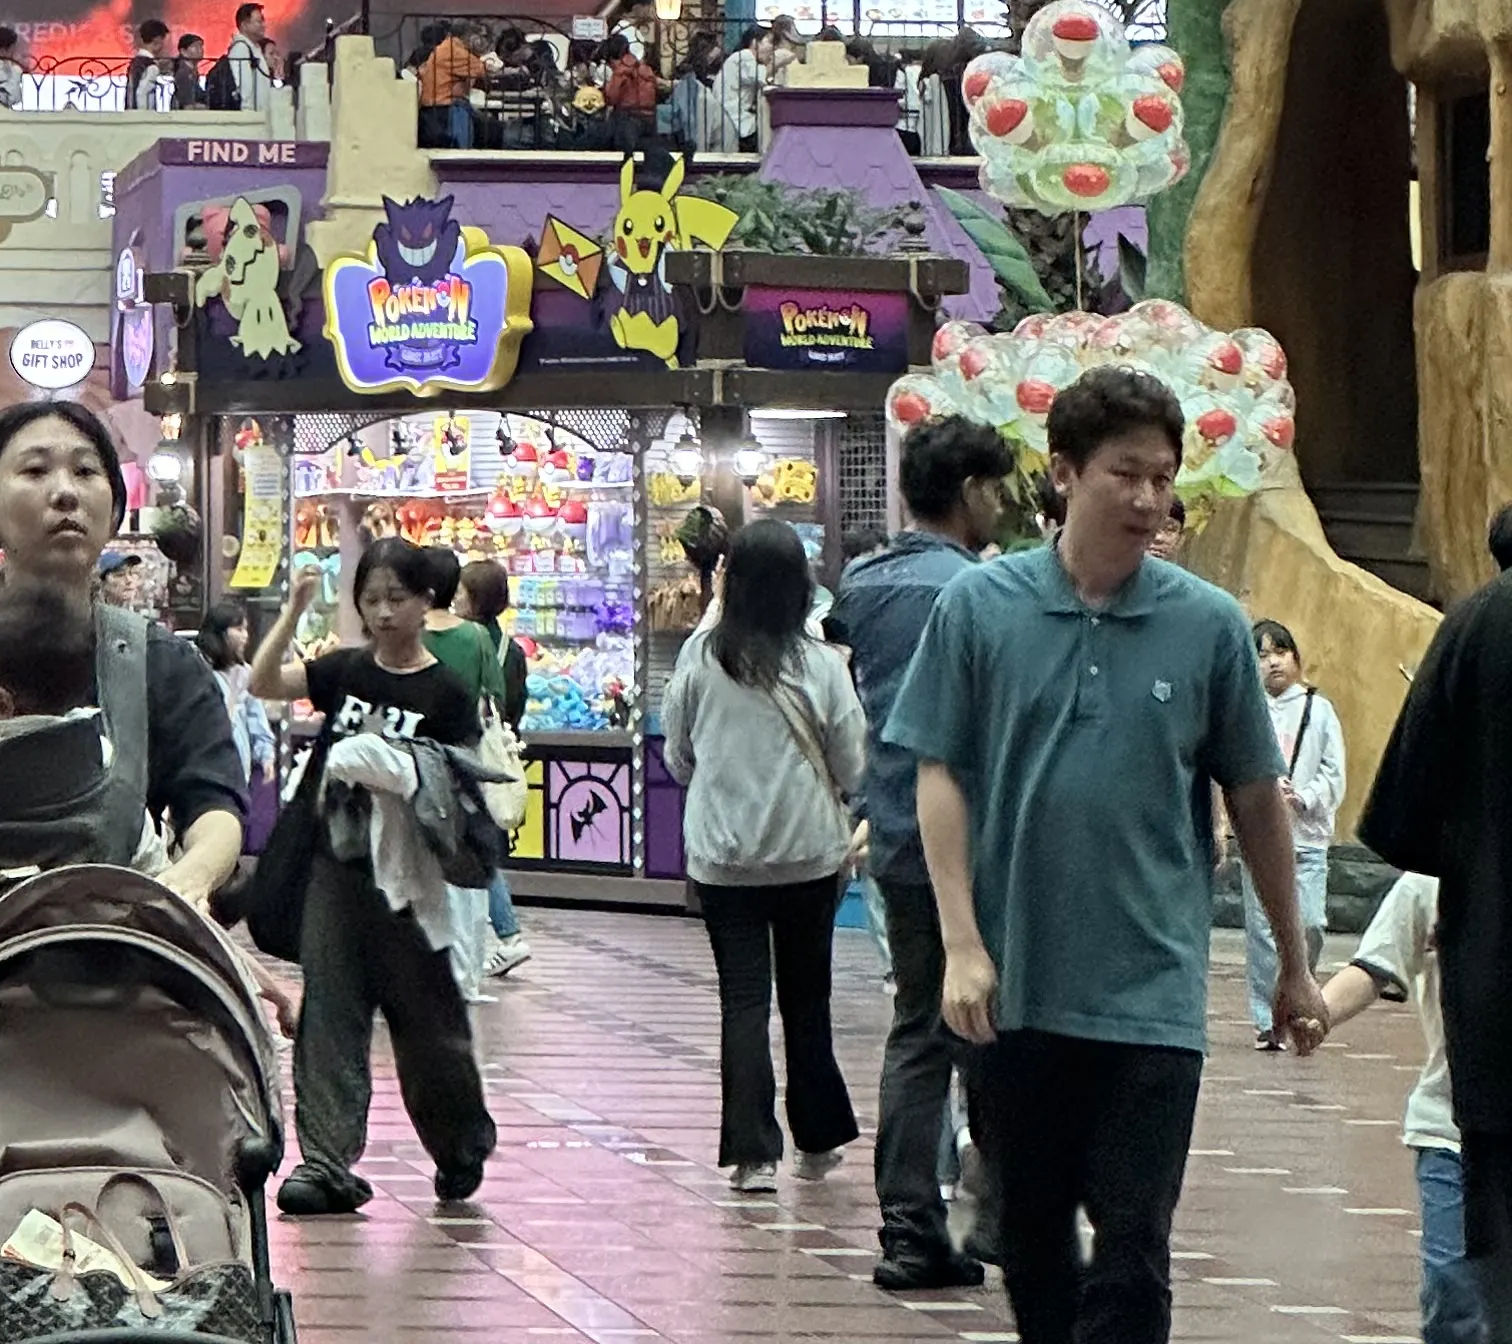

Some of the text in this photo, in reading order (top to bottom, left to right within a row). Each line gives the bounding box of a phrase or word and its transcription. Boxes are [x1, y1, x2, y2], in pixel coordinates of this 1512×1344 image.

[188, 140, 296, 164] FIND ME
[22, 353, 83, 369] GIFT SHOP
